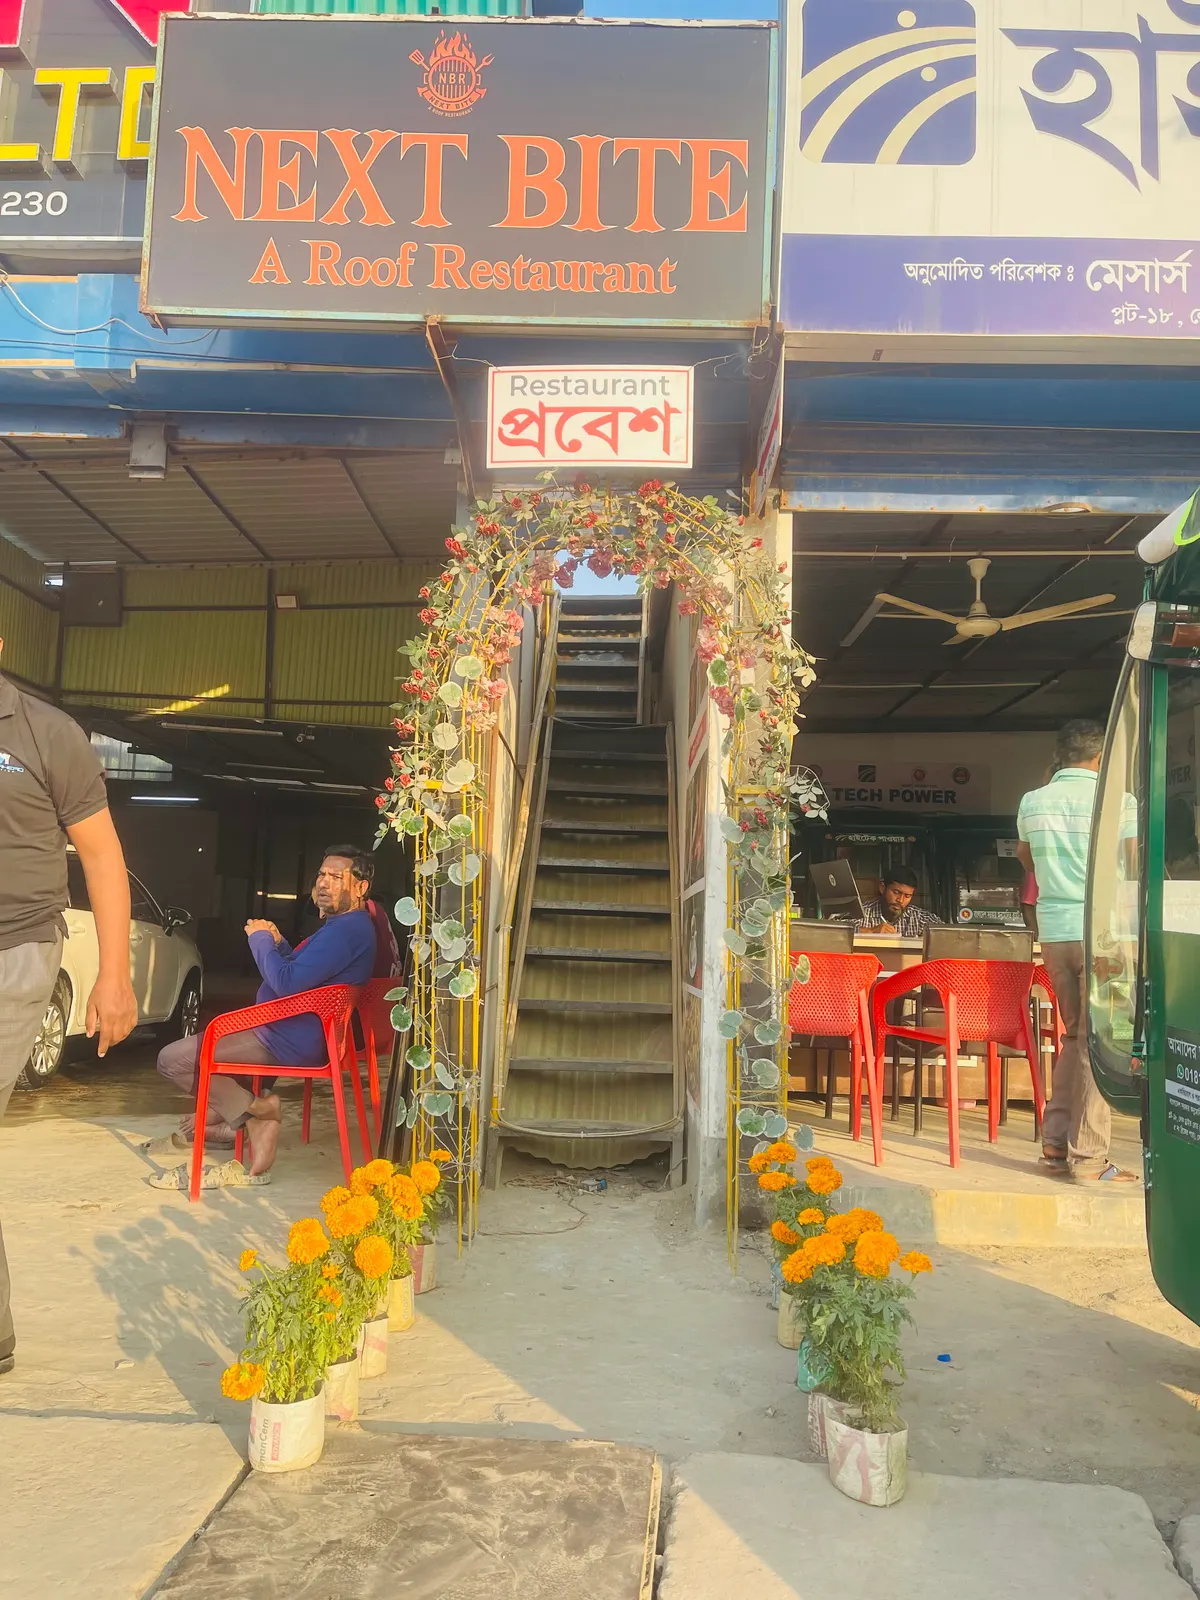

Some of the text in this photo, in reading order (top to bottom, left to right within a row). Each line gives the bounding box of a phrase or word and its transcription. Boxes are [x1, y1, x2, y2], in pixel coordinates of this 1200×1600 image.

[439, 73, 466, 84] NBR
[428, 96, 475, 109] NEXT BITE
[171, 126, 748, 232] NEXT BITE
[1, 191, 68, 216] 230
[248, 237, 678, 293] A Roof Restaurant
[903, 257, 985, 286] অনুমোদিত
[989, 258, 1062, 283] পরিবেশক
[1086, 249, 1194, 294] মেসার্স
[510, 375, 670, 396] Restaurant
[498, 399, 682, 458] প্রবেশ
[832, 787, 957, 804] TECH POWER
[1167, 1037, 1197, 1060] আমাদের
